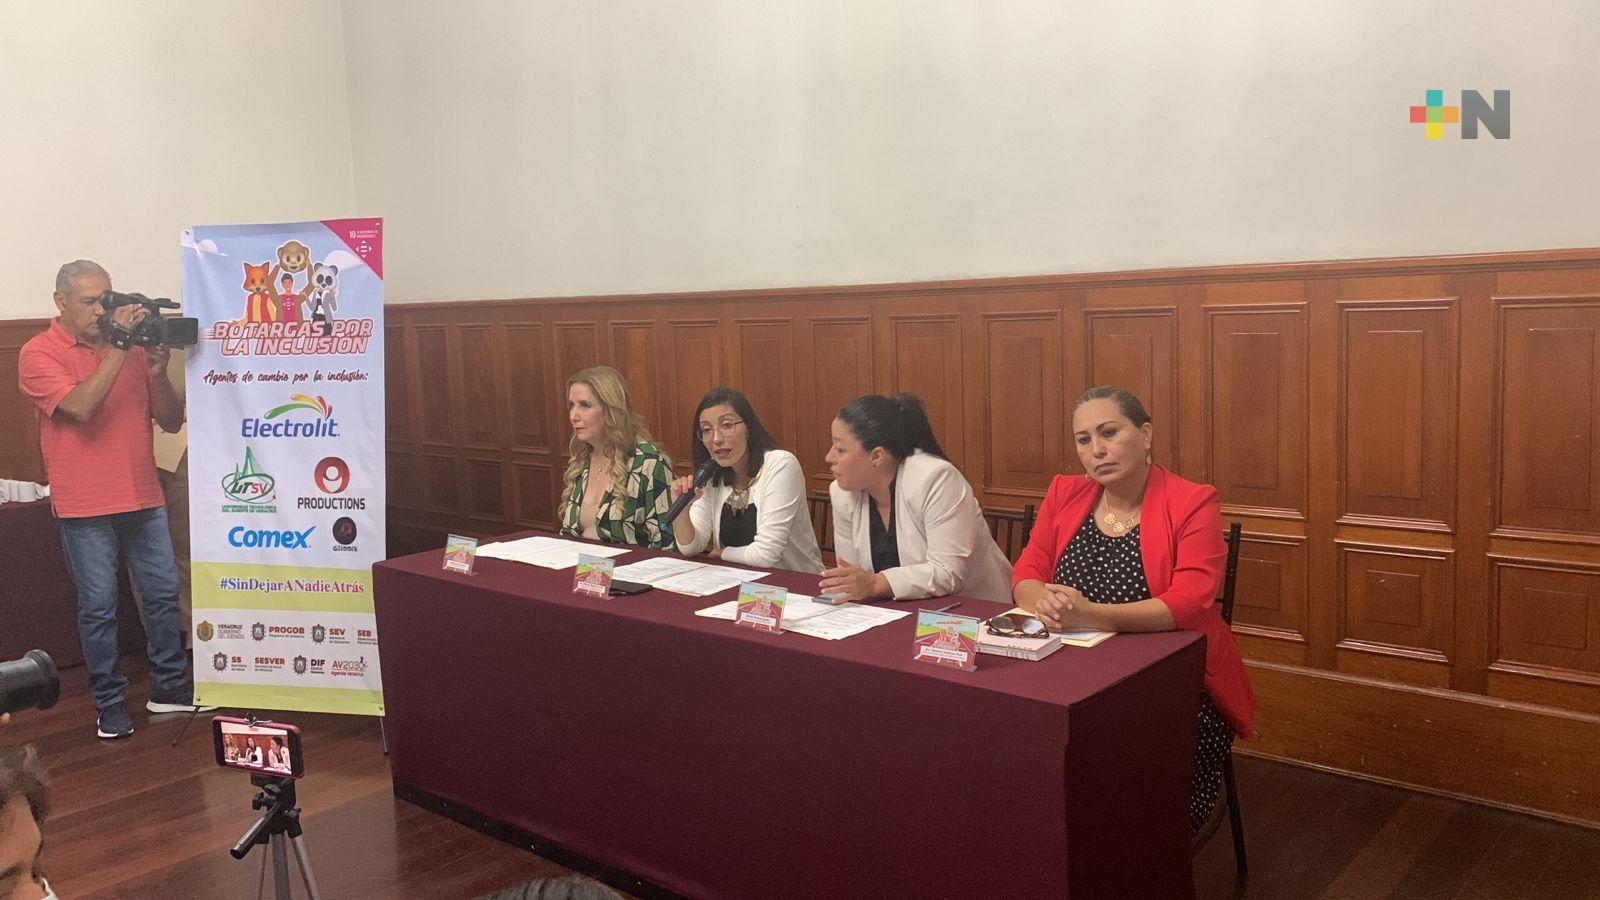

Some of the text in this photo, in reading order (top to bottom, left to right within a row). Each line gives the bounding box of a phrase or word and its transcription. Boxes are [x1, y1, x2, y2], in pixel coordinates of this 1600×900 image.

[214, 318, 373, 339] BOTARGAS POR
[220, 337, 250, 356] LA
[203, 369, 238, 385] Agentes
[241, 370, 253, 383] de
[257, 370, 289, 382] cambio
[292, 372, 309, 384] por
[313, 369, 323, 383] la
[297, 497, 366, 510] PRODUCTIONS
[228, 525, 317, 549] Comex
[220, 578, 364, 593] #SinDejarANadieAtrás
[269, 626, 305, 634] PROGOB
[329, 628, 346, 636] SEV
[357, 629, 372, 637] SEB
[254, 657, 285, 665] SESVER
[310, 659, 325, 667] DIF
